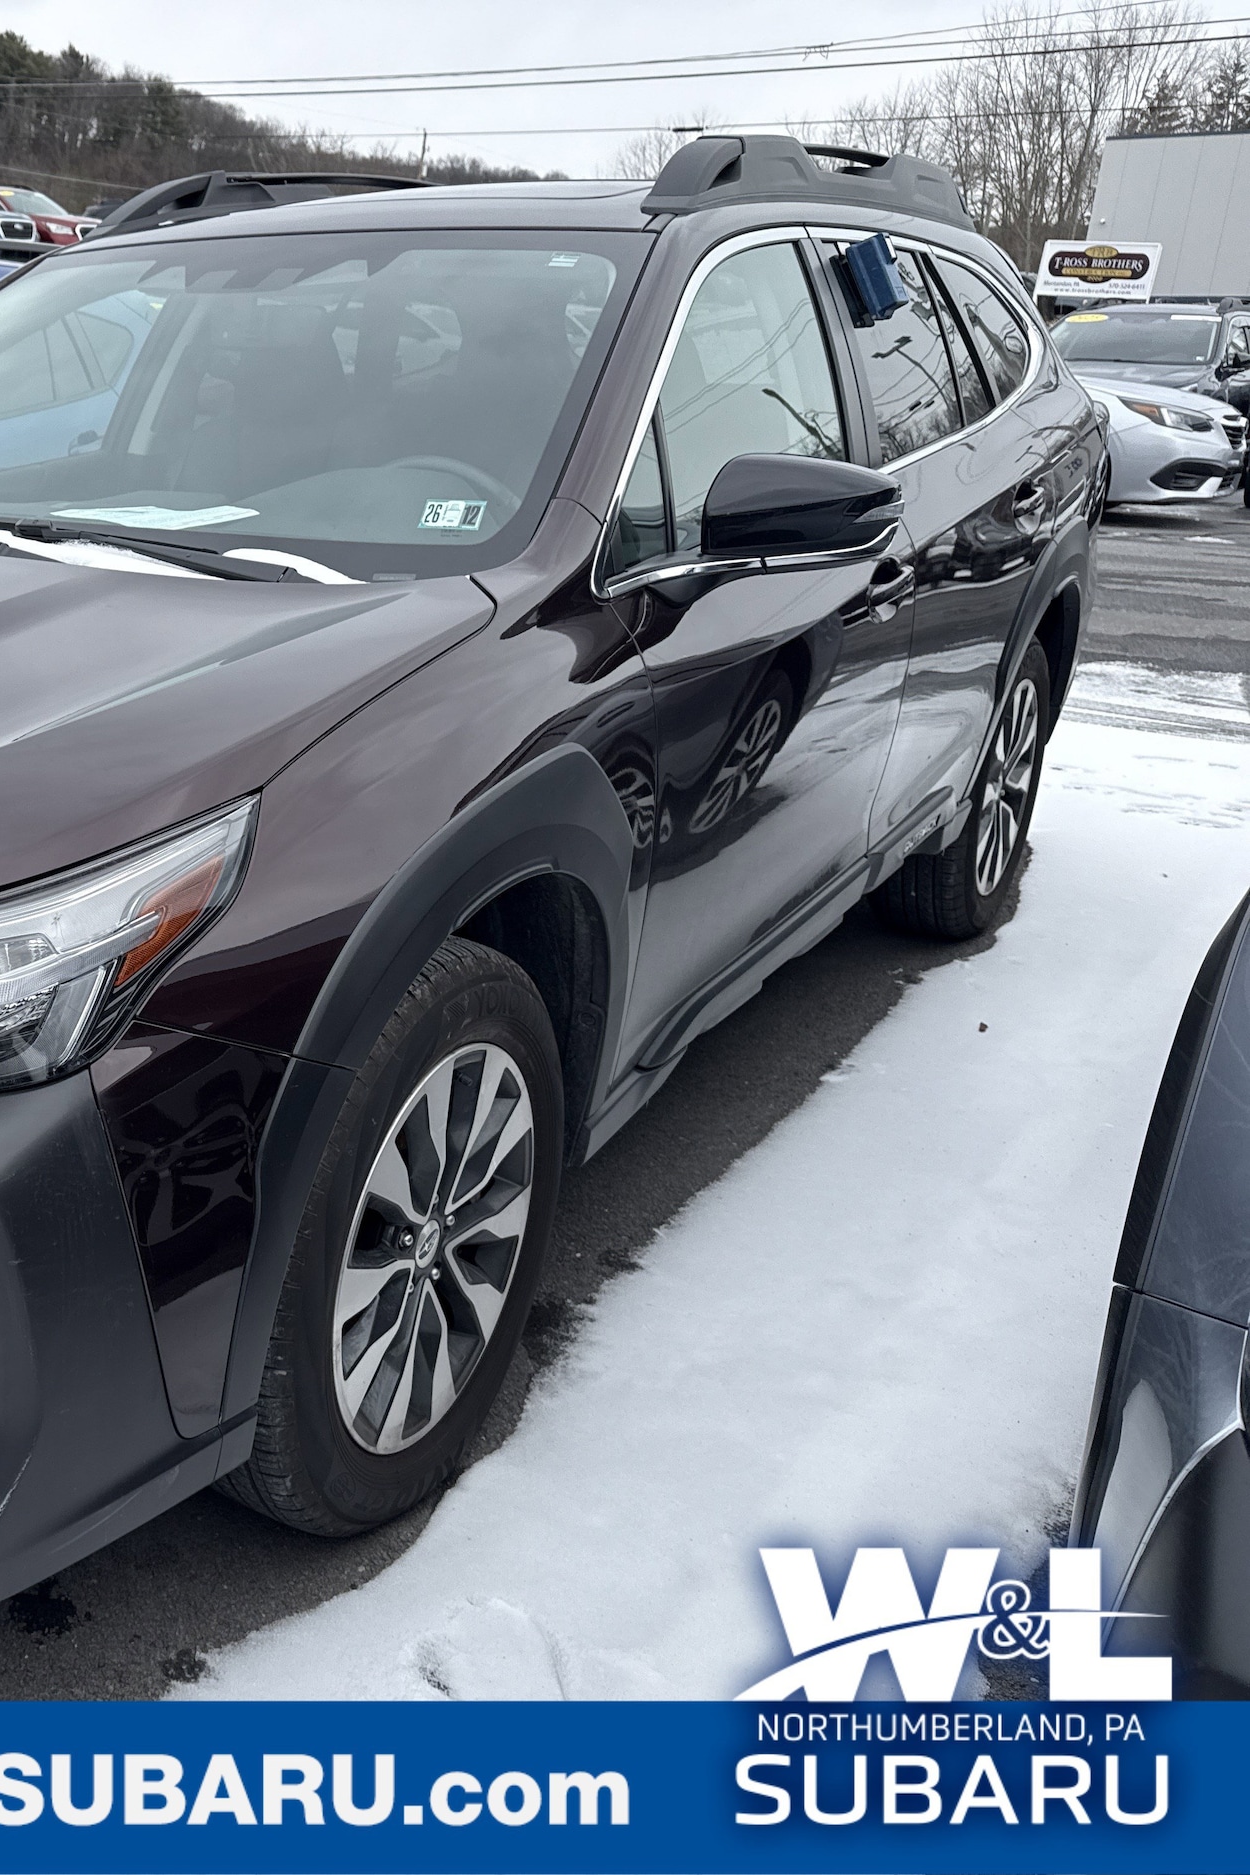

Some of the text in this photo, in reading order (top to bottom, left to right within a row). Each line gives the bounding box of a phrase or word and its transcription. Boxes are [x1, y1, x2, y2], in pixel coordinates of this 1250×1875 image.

[1054, 257, 1144, 272] T-ROSS BROTHERS
[424, 503, 443, 523] 26
[461, 505, 481, 526] 12
